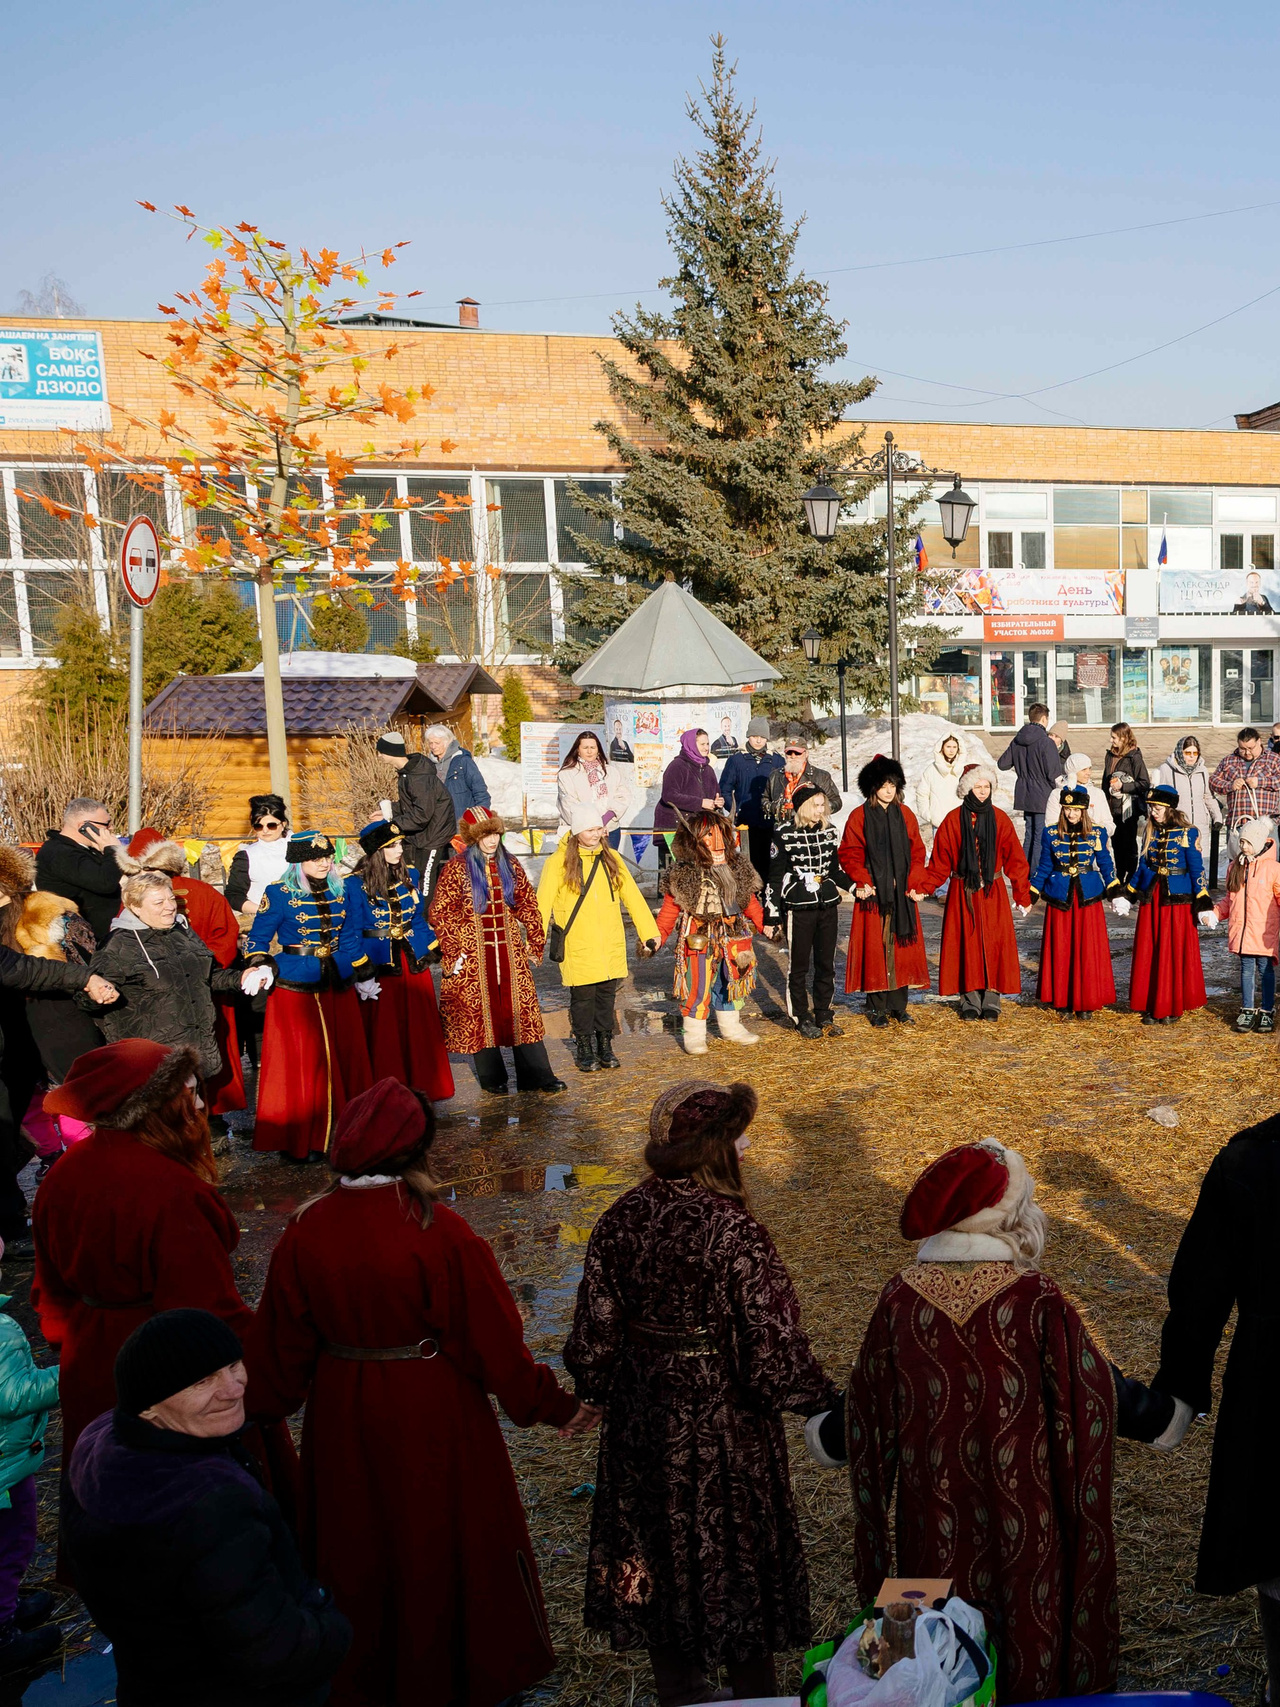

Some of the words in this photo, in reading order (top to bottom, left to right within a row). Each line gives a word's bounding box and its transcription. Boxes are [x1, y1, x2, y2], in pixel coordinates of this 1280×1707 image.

[37, 332, 50, 340] НА
[49, 347, 96, 361] БОКС
[35, 363, 99, 378] САМБО
[35, 380, 101, 396] ДЗЮДО
[1057, 584, 1093, 596] День
[1173, 581, 1230, 589] АЛЕКСАНДР
[1180, 590, 1223, 600] ШАТО
[1007, 598, 1060, 609] работника
[1063, 599, 1109, 610] культуры
[991, 619, 1057, 628] ИЗБИРАТЕЛЬНЫЙ
[714, 710, 738, 719] ШАТО
[423, 849, 437, 896] BLACKSQUAD
